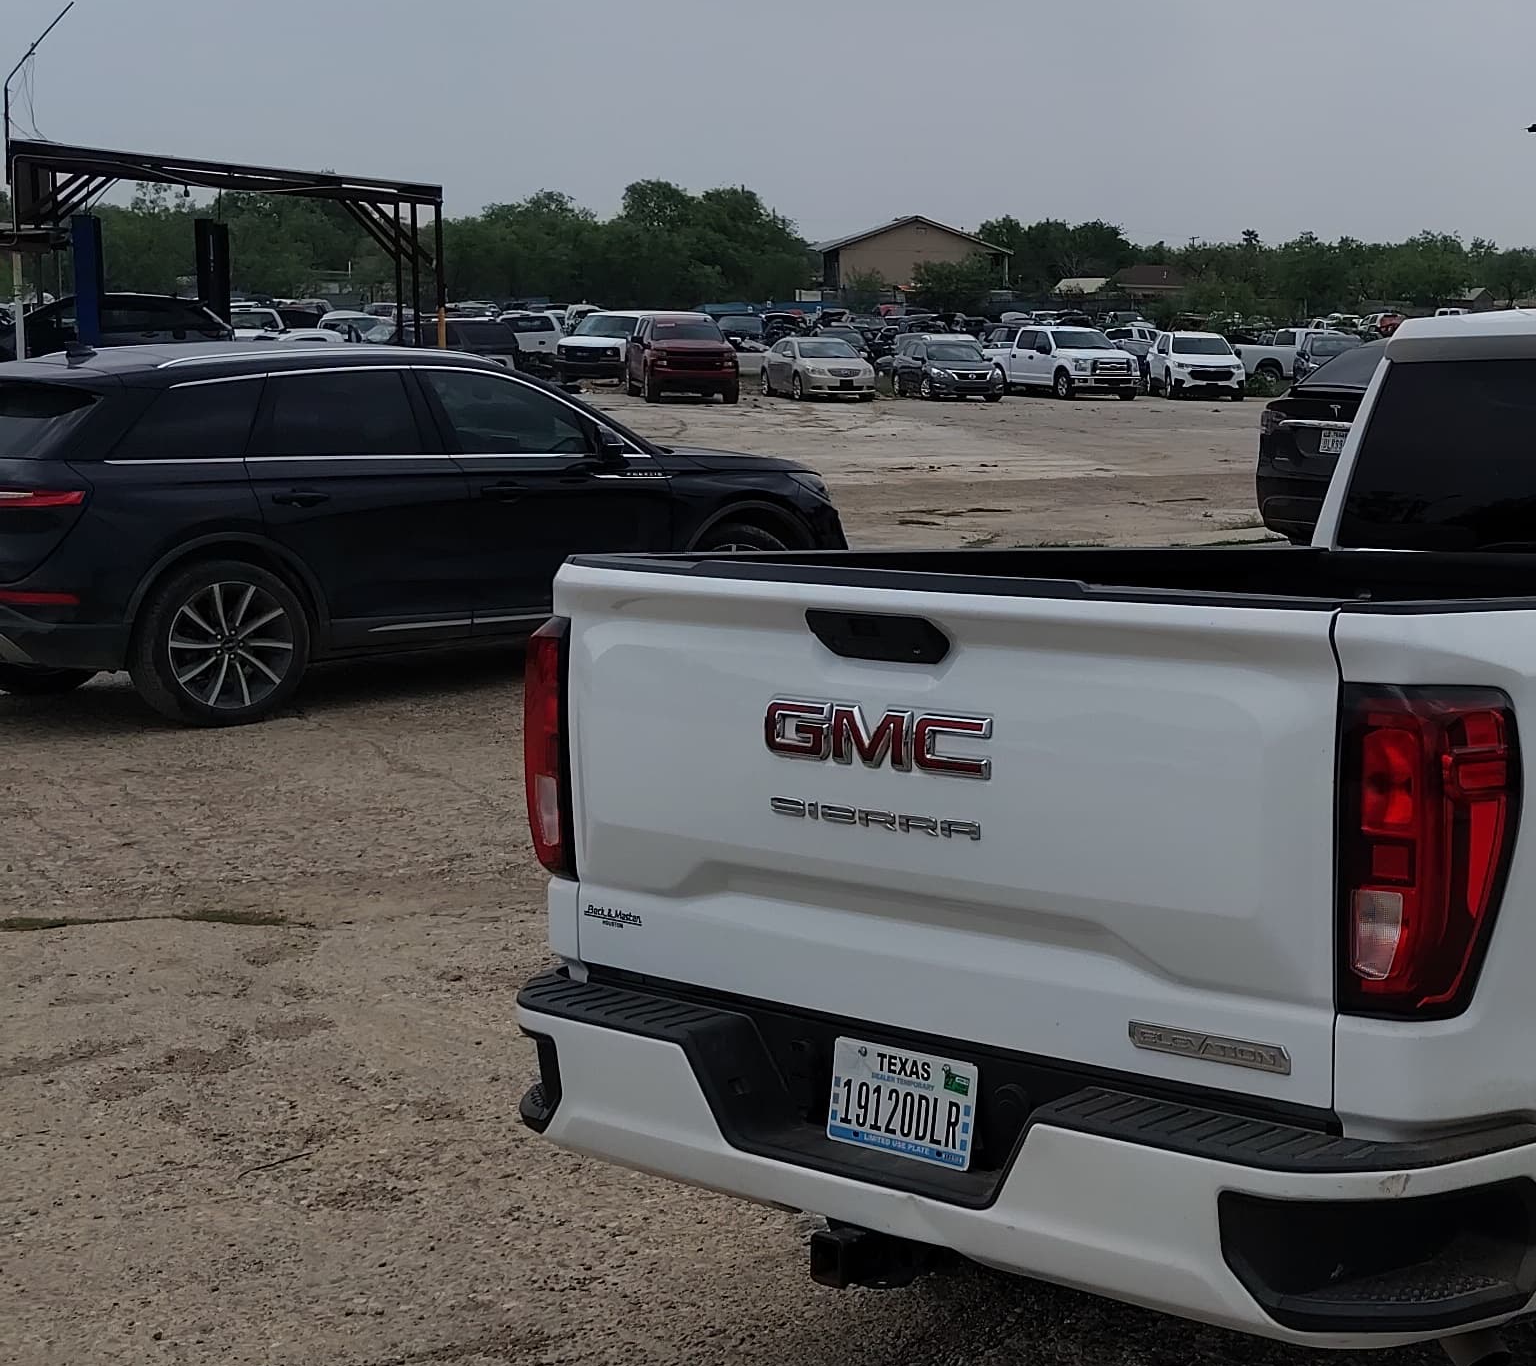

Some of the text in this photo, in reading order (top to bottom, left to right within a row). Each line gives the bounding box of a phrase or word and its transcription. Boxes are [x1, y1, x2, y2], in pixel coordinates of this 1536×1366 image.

[765, 699, 993, 780] GMC
[770, 795, 981, 841] SIERRA
[876, 1052, 931, 1082] TEXAS
[1138, 1028, 1276, 1066] ELEVATION
[839, 1078, 961, 1150] 19120DLR
[863, 1133, 930, 1156] LIMITED USE PLATE
